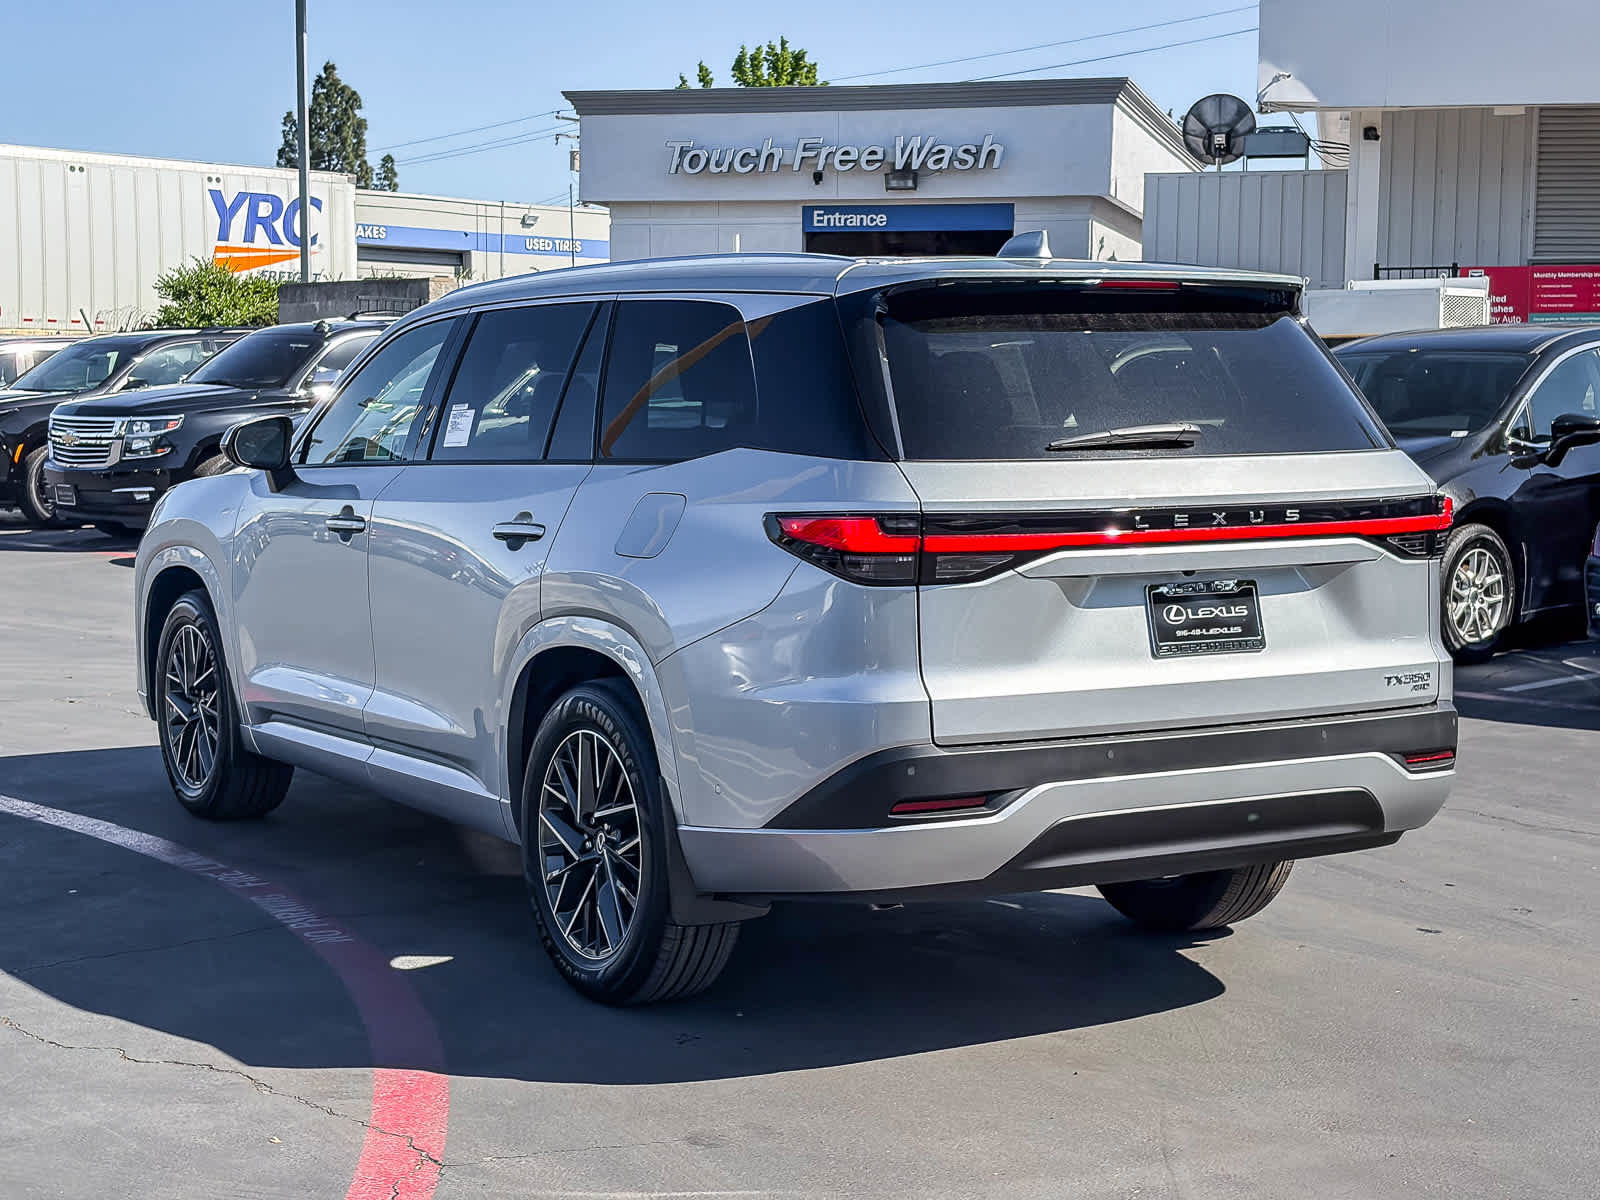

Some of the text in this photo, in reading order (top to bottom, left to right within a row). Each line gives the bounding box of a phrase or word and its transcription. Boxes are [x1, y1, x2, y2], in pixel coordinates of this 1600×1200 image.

[665, 133, 1005, 174] Touch Free Wash
[207, 189, 323, 248] YRC
[812, 210, 888, 227] Entrance
[525, 237, 582, 253] USED TIRES
[261, 270, 322, 281] FREIGT
[1533, 272, 1557, 280] Monthly
[1557, 271, 1593, 279] Membership
[1502, 314, 1522, 324] Auto
[1134, 509, 1301, 529] LEXUS
[1187, 605, 1249, 619] LEXUS
